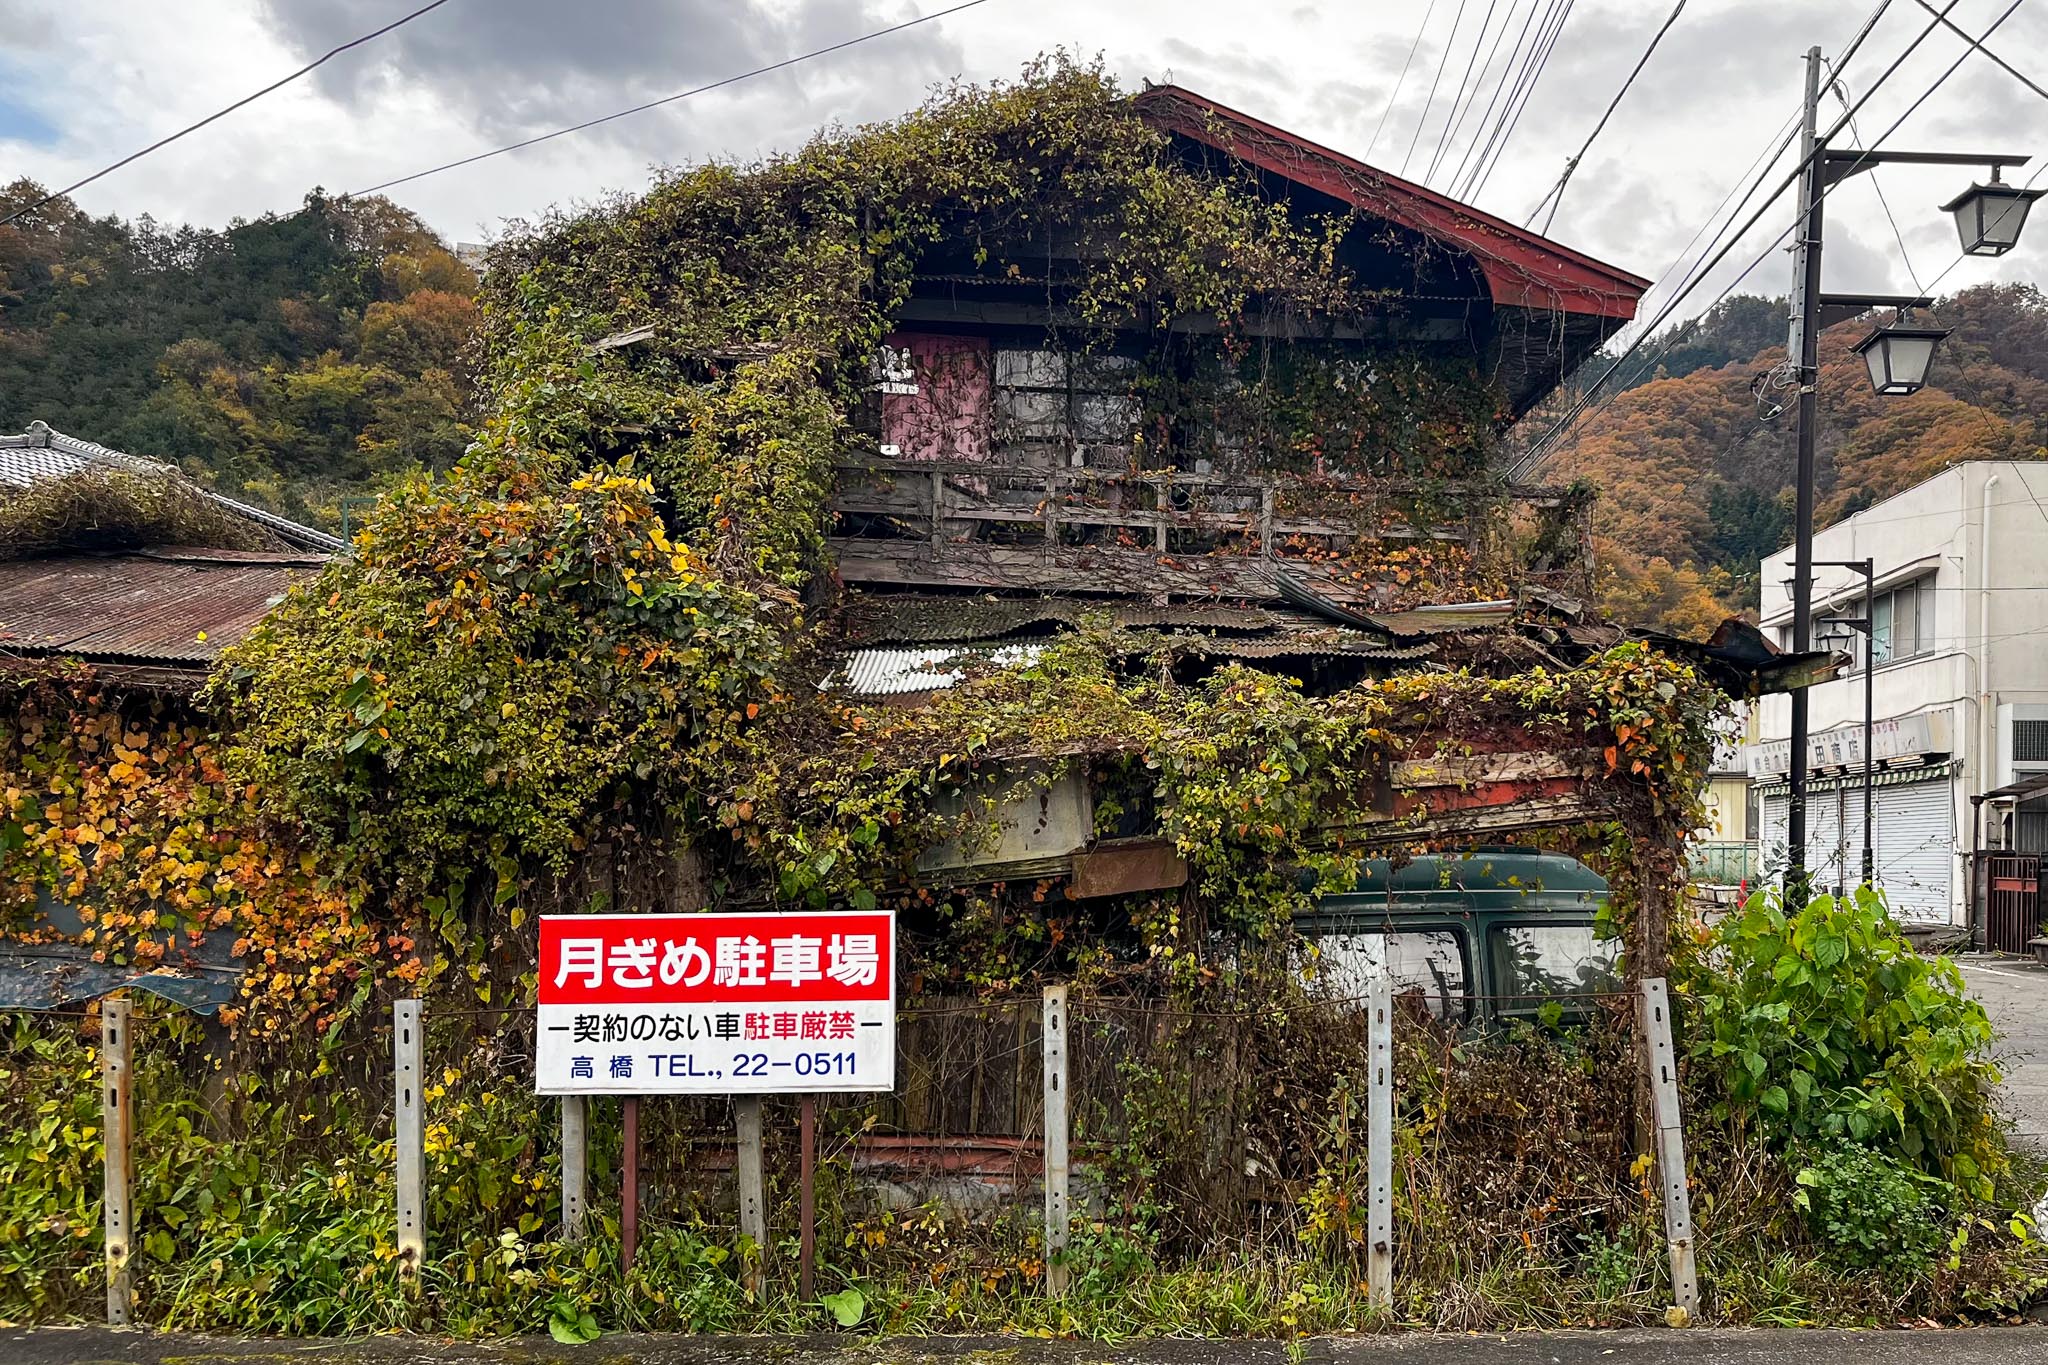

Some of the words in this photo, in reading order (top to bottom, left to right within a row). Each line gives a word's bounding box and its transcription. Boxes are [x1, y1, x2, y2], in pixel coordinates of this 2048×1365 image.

[553, 934, 879, 988] 月ぎめ駐車場
